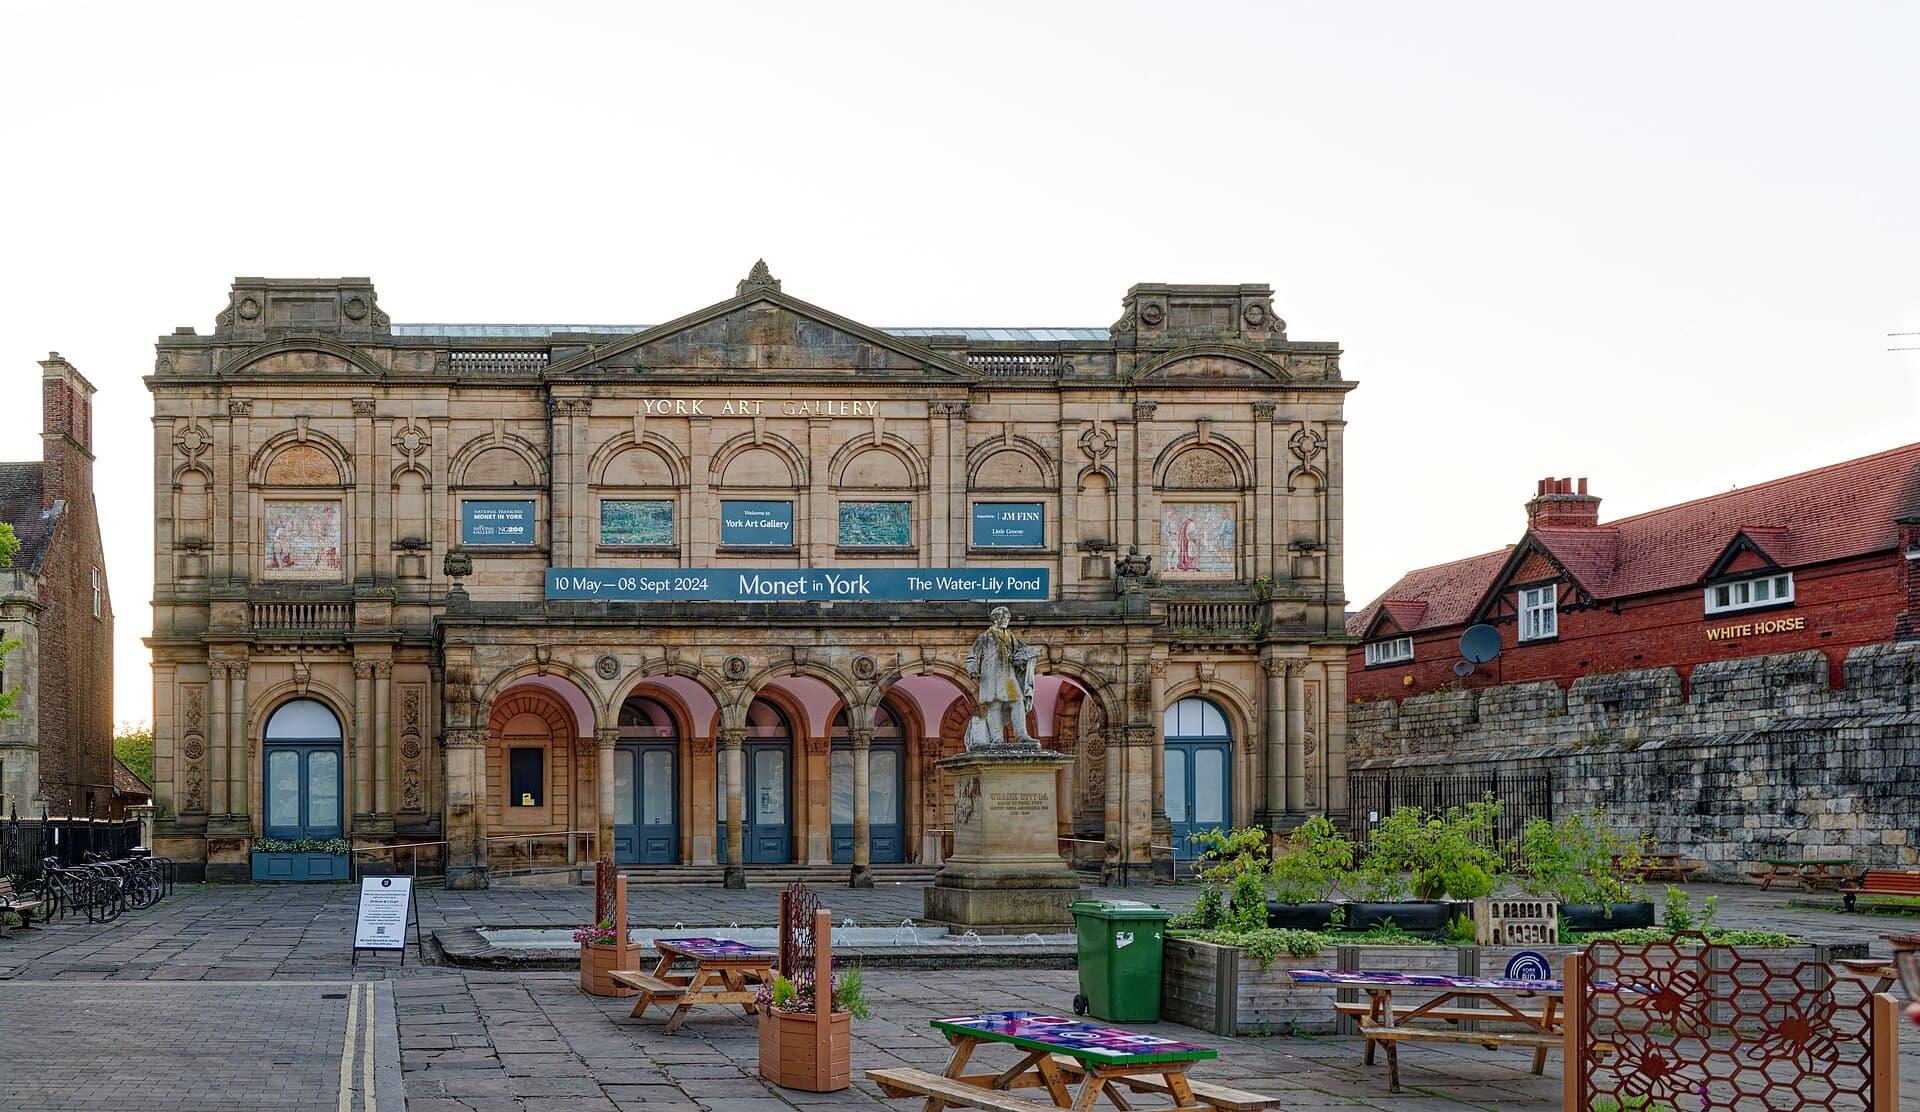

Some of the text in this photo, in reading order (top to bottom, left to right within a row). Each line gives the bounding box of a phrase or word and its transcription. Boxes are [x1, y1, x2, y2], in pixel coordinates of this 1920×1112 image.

[642, 399, 878, 416] YORK ART GALLERY
[725, 519, 789, 530] York Art Gallery
[1002, 512, 1015, 521] JM
[1017, 512, 1039, 521] FINN
[554, 577, 569, 591] 10
[640, 577, 670, 594] Sept
[674, 577, 709, 591] 2024
[739, 575, 807, 595] Monet
[812, 579, 823, 591] in
[825, 574, 870, 594] York
[907, 577, 933, 591] The
[935, 576, 1003, 594] Water-Lily
[1007, 576, 1040, 591] Pond
[1706, 617, 1805, 640] WHITE HORSE
